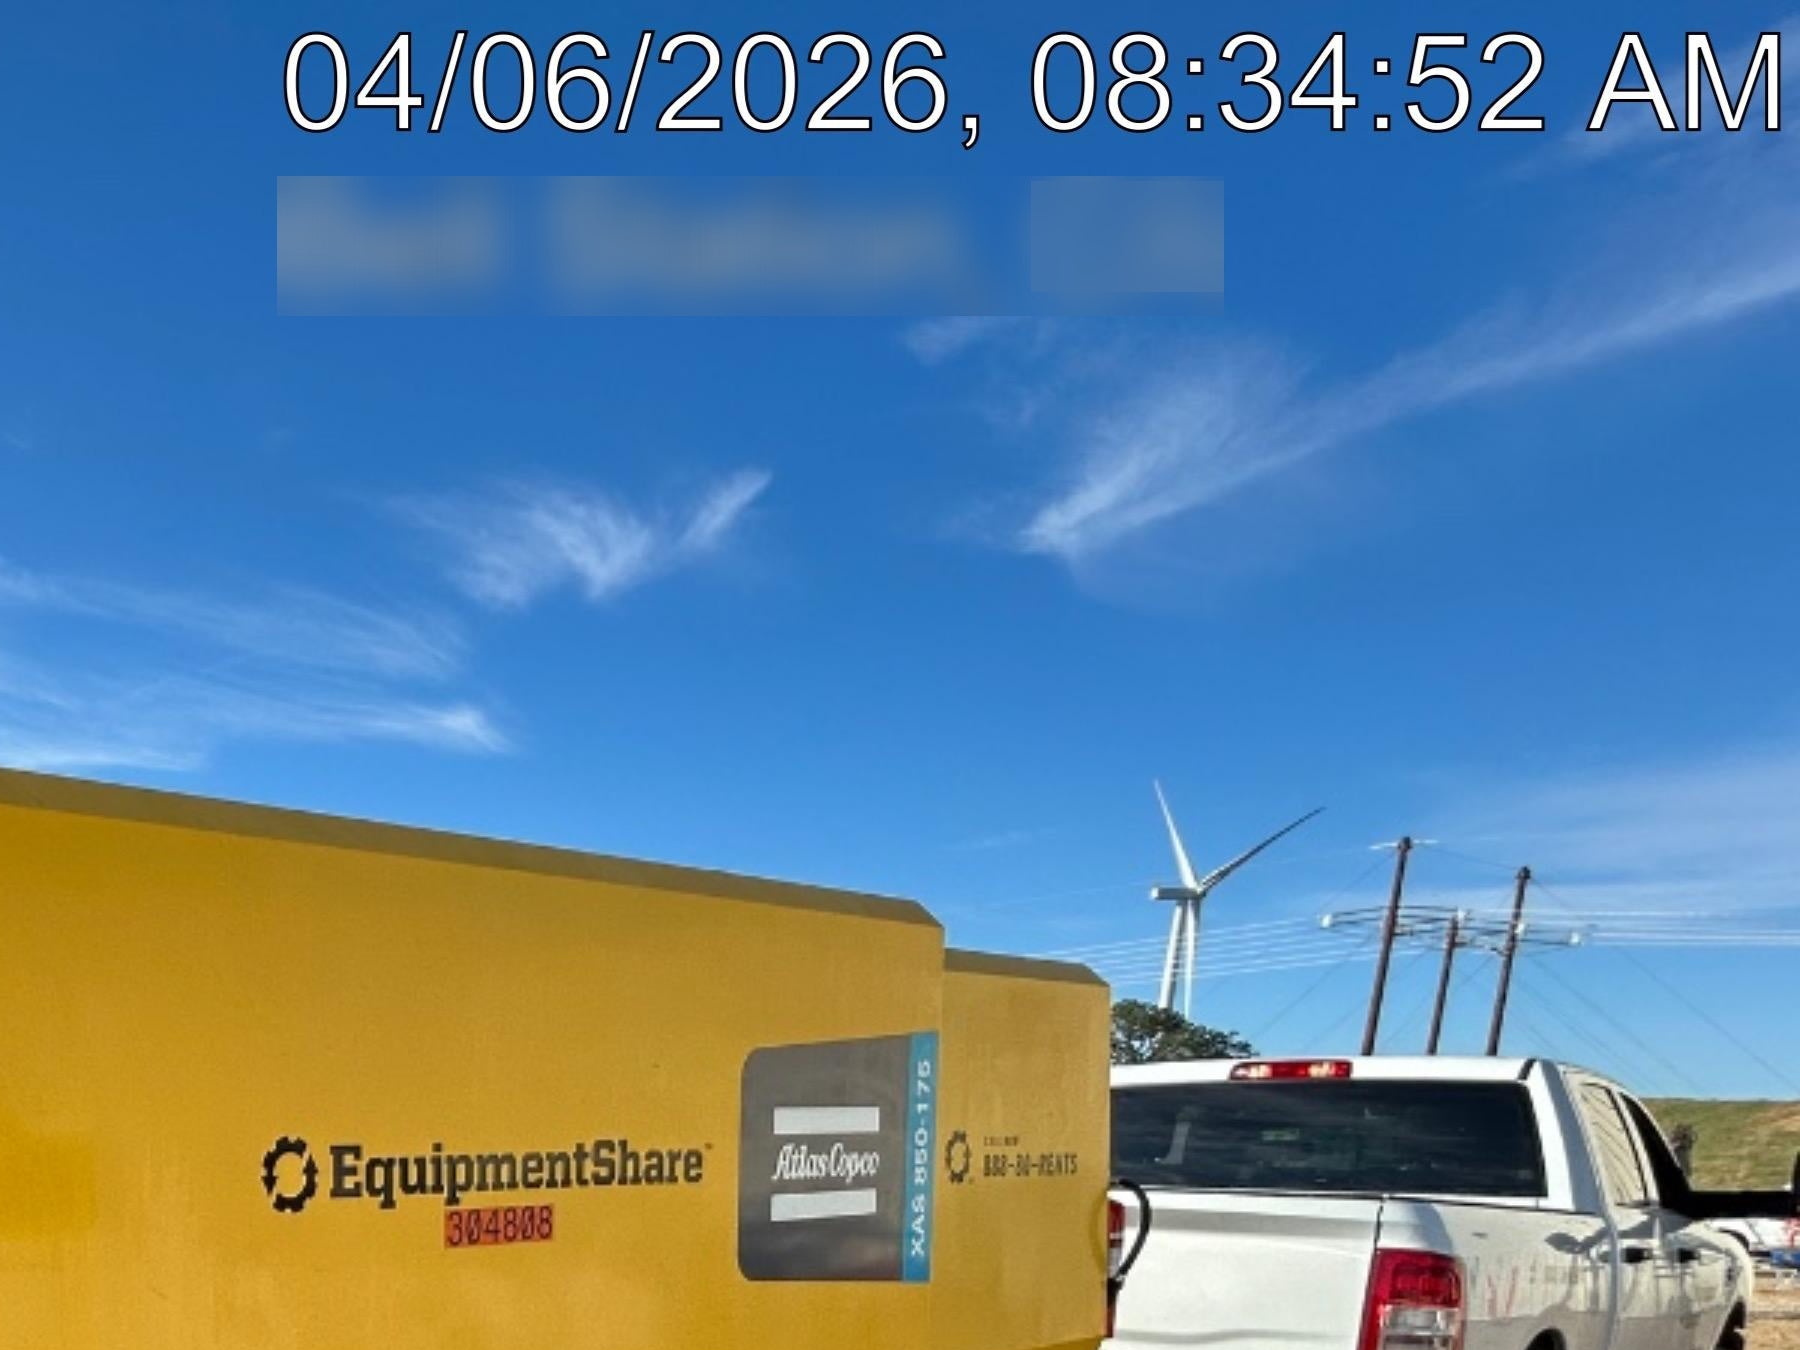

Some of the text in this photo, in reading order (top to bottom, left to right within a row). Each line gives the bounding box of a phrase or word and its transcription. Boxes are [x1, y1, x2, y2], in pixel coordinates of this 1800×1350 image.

[328, 1138, 705, 1210] EquipmentShare
[770, 1142, 880, 1185] Atlas Copco
[447, 1206, 554, 1247] 304808
[910, 1193, 927, 1258] XAS
